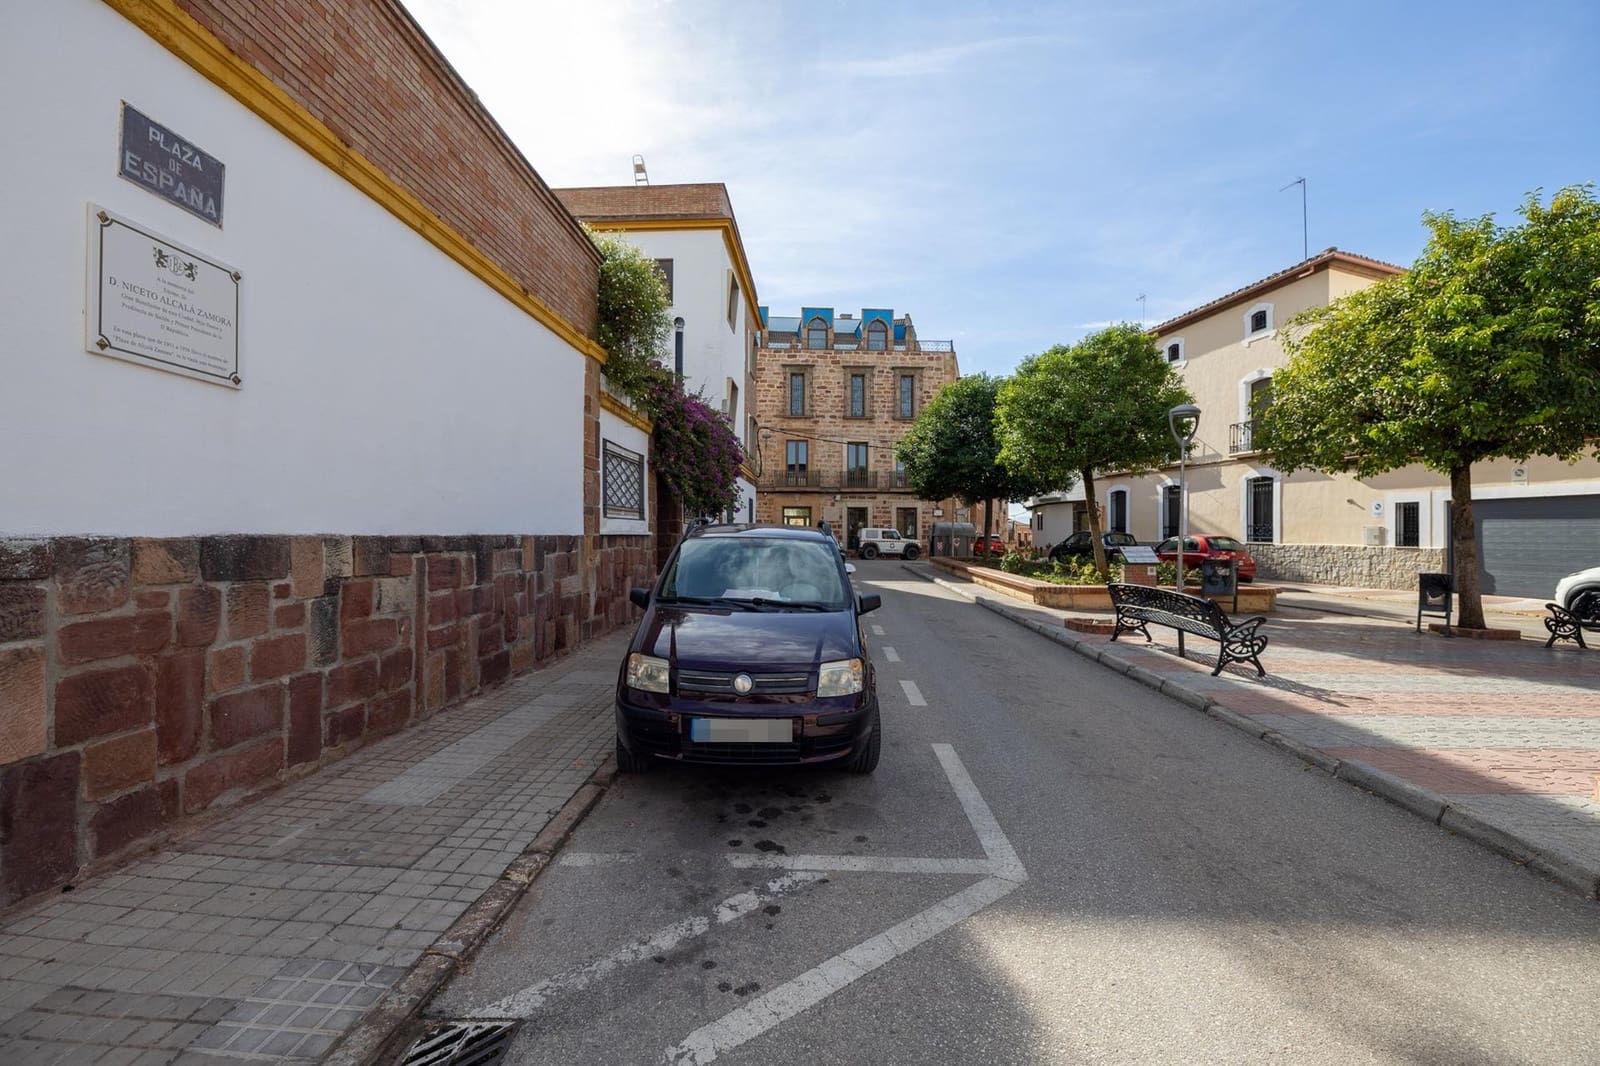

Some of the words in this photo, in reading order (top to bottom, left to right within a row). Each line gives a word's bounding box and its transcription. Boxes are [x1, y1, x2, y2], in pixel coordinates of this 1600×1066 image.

[148, 126, 202, 171] PLAZA
[169, 158, 182, 177] DE
[125, 149, 217, 218] ESPAÑA
[109, 276, 119, 287] D.
[122, 281, 158, 301] NICETO
[160, 296, 195, 314] ALCALÁ
[197, 308, 231, 327] ZAMORA
